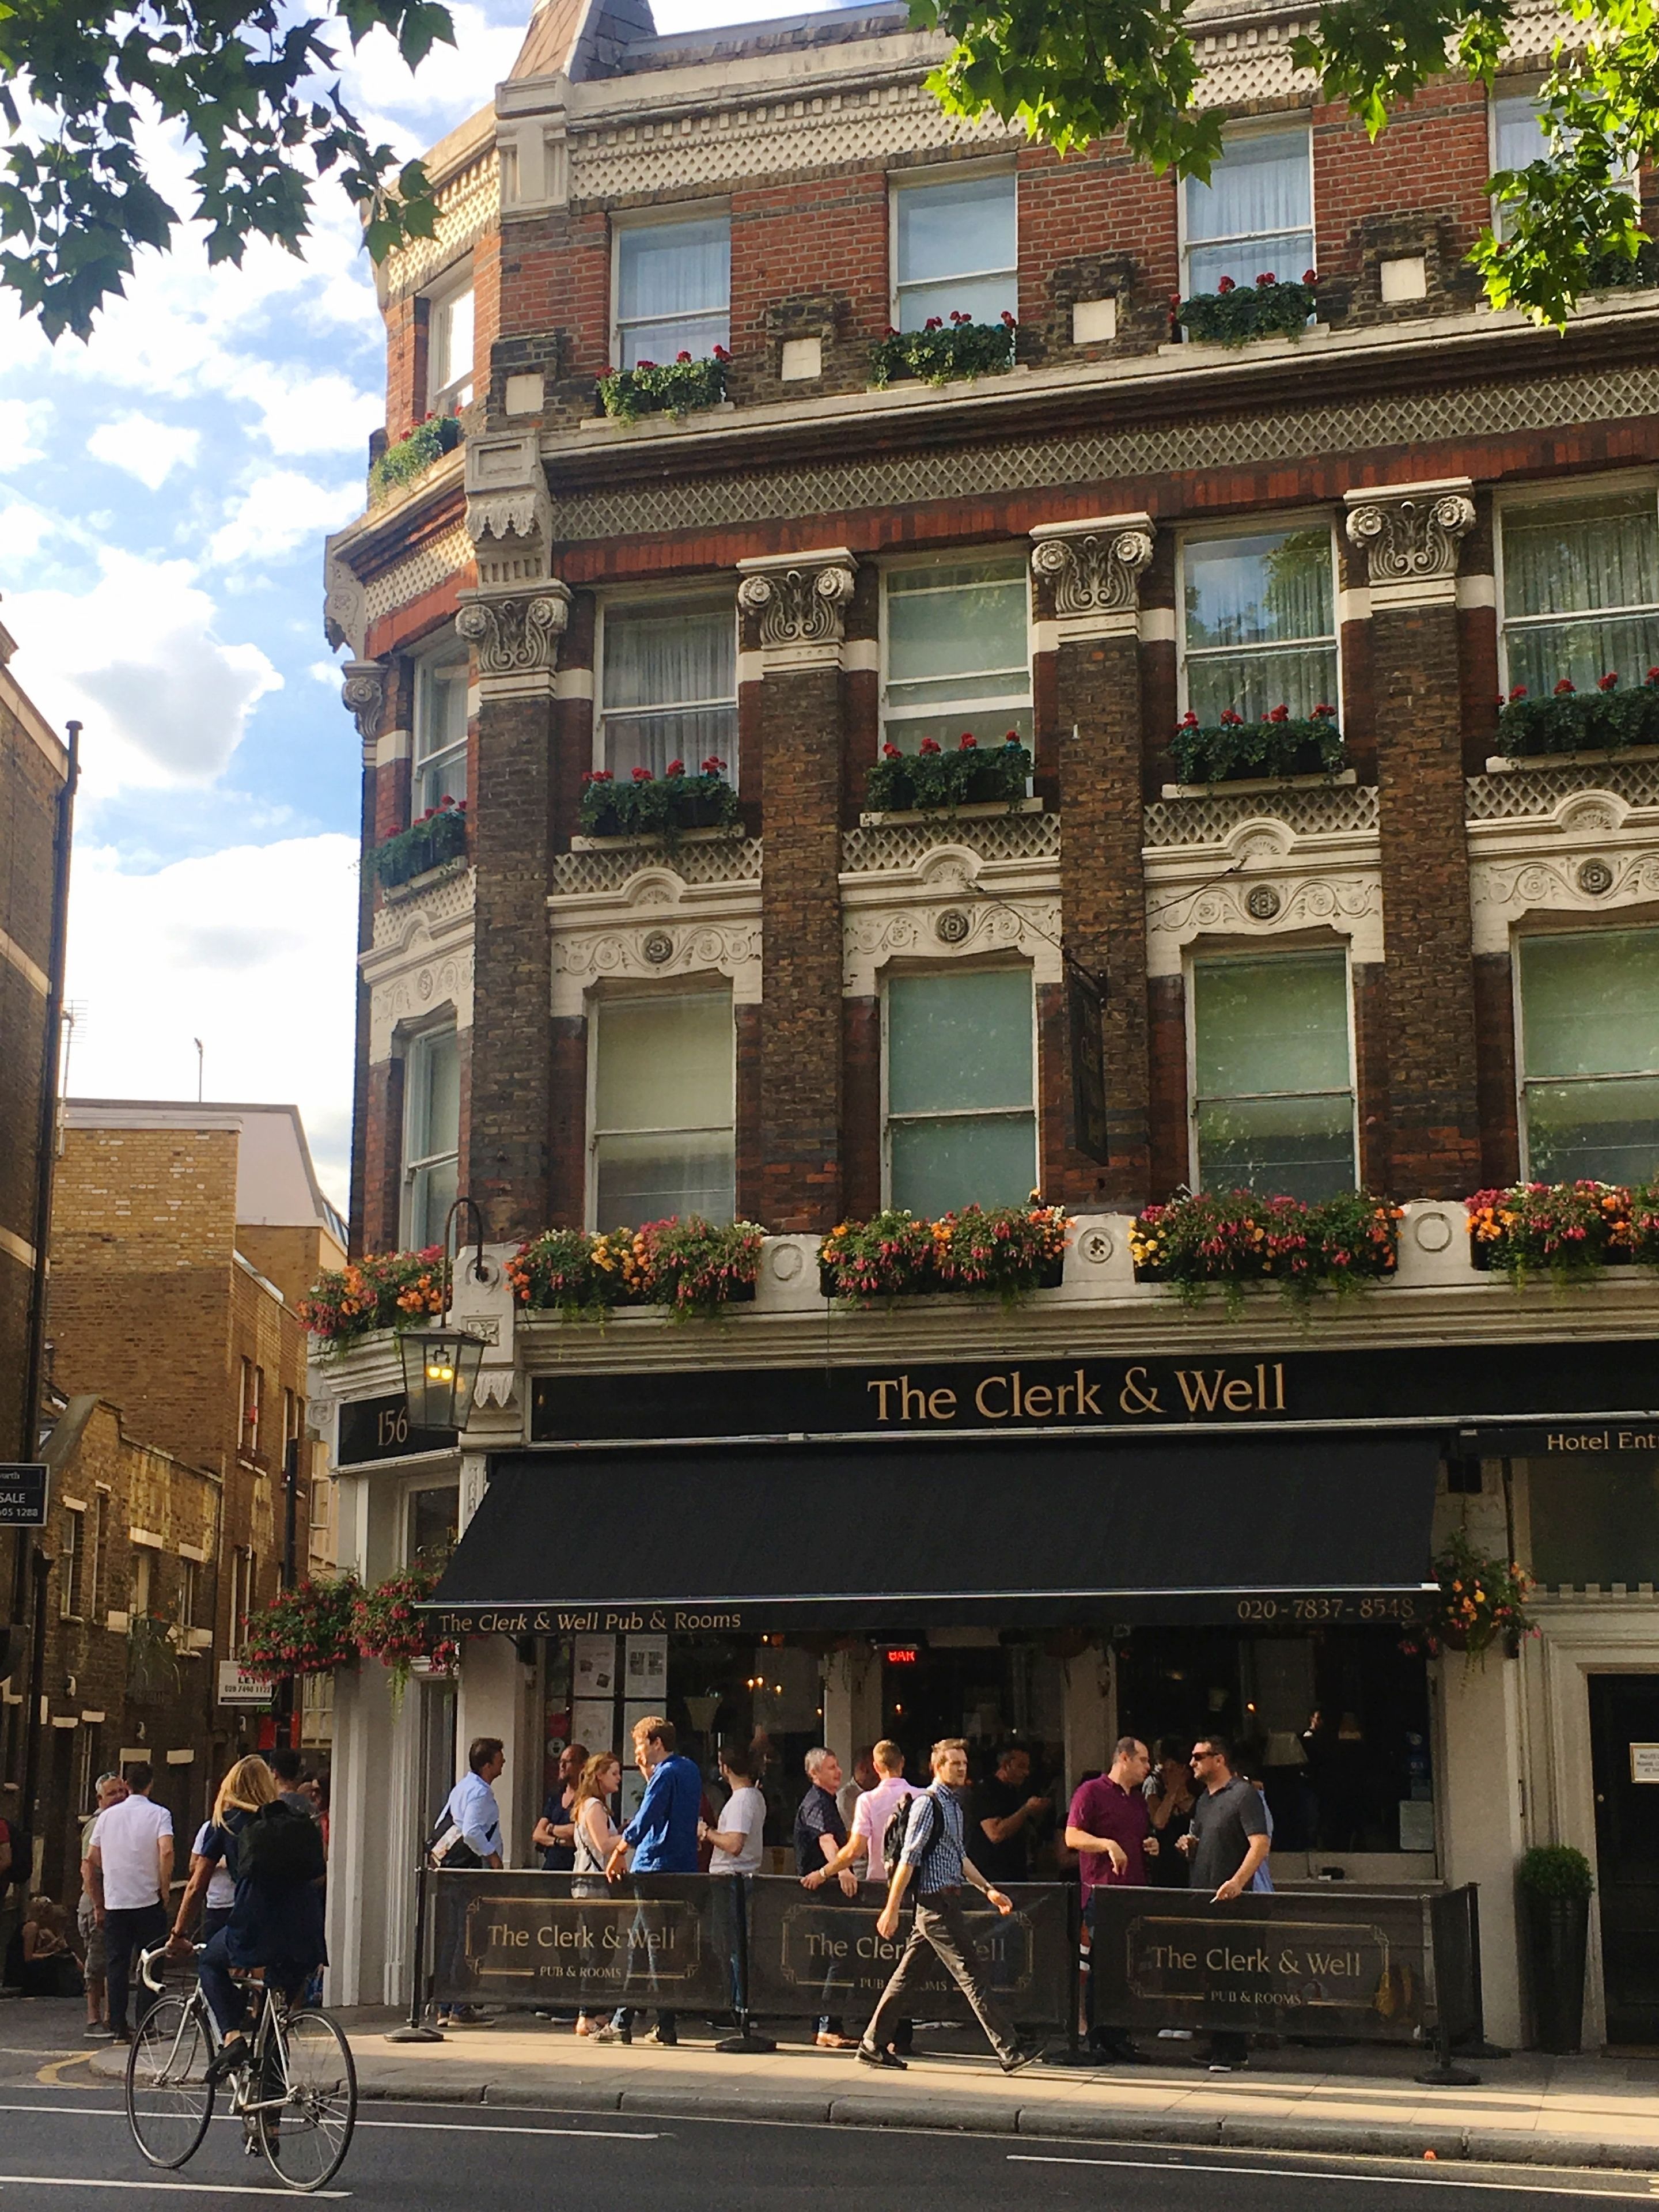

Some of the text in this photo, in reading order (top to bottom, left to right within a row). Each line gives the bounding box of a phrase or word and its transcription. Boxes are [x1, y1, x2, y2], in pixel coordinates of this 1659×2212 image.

[867, 1363, 1287, 1421] The Clerk & Well
[378, 1406, 408, 1446] 156
[1547, 1430, 1659, 1450] Hotel Ent
[0, 1508, 13, 1516] 05
[438, 1609, 741, 1632] The Clerk & Well Pub & Rooms
[889, 1651, 915, 1661] BAR
[488, 1924, 675, 1949] The Clerk & Well
[805, 1933, 1005, 1961] The Cler ell
[540, 1965, 622, 1978] PUB & ROOMS
[1152, 1946, 1360, 1976] The Clerk & Well
[860, 1978, 884, 1988] PUB
[1211, 1992, 1301, 2005] PUB & ROOMS
